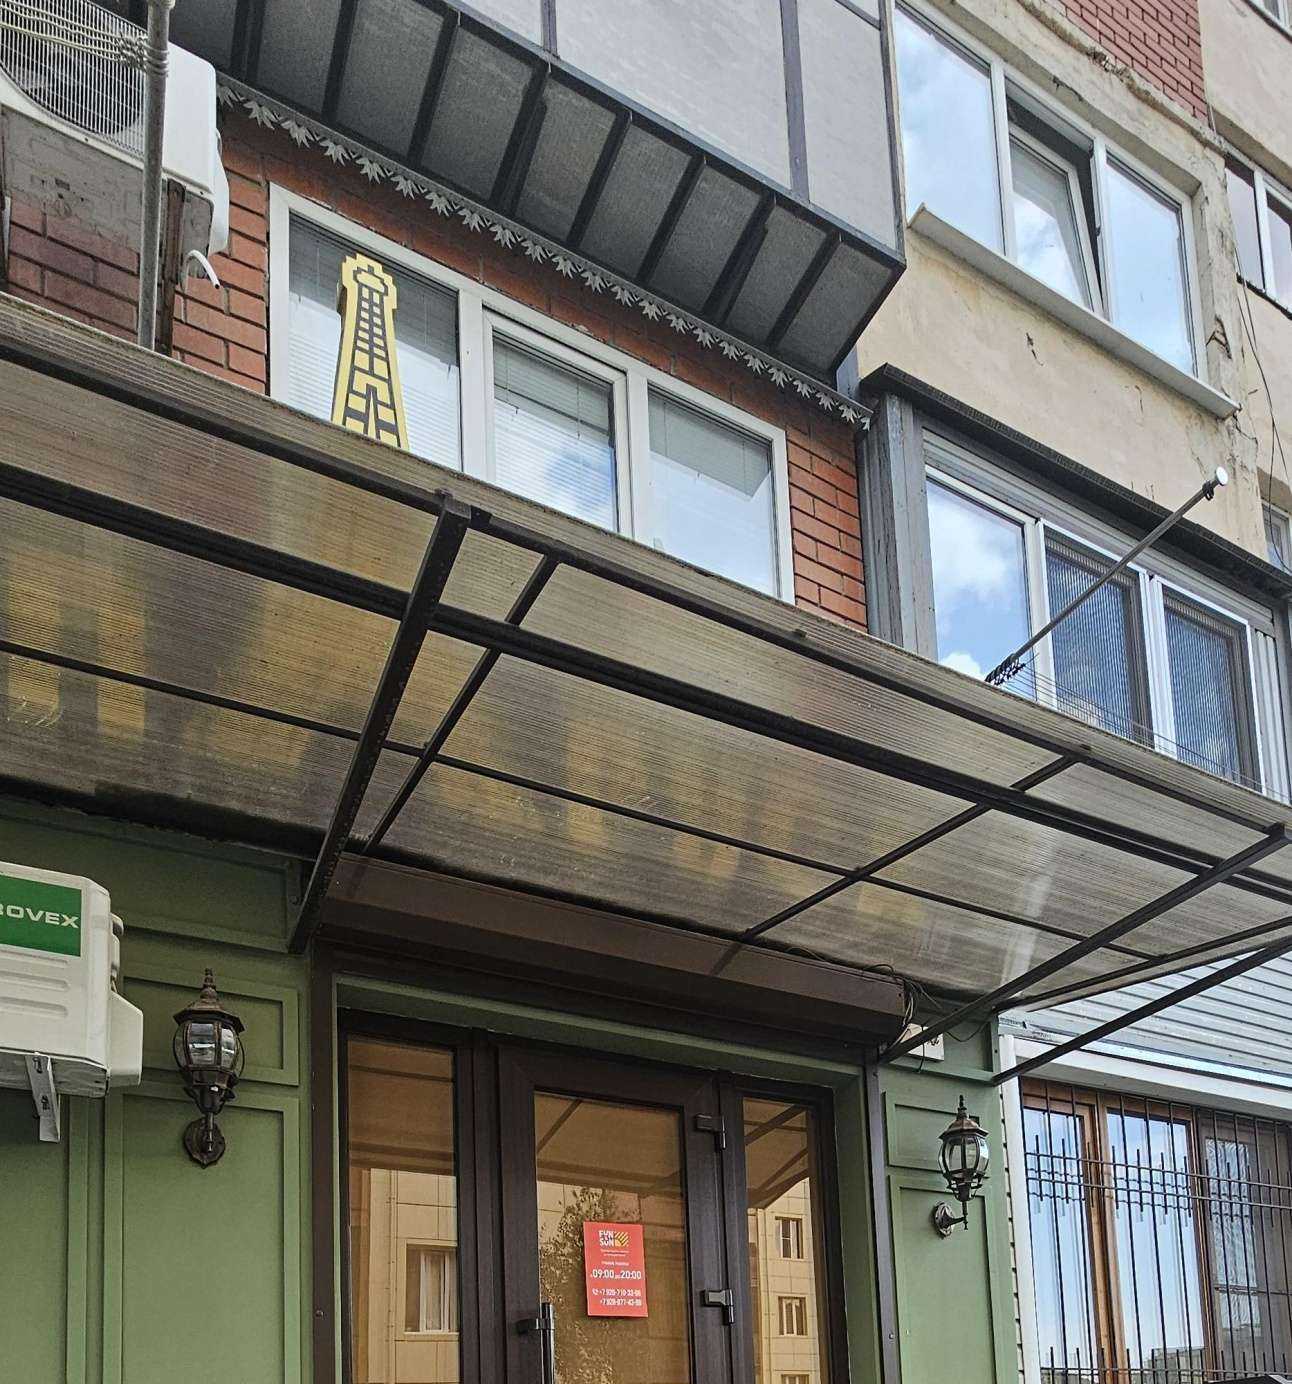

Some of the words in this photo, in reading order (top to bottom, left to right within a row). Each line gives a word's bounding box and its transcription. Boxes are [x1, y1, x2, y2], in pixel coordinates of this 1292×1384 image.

[0, 903, 79, 929] OVEX
[599, 1238, 614, 1247] SUN
[592, 1268, 614, 1279] 09:00
[621, 1270, 642, 1280] 20:00
